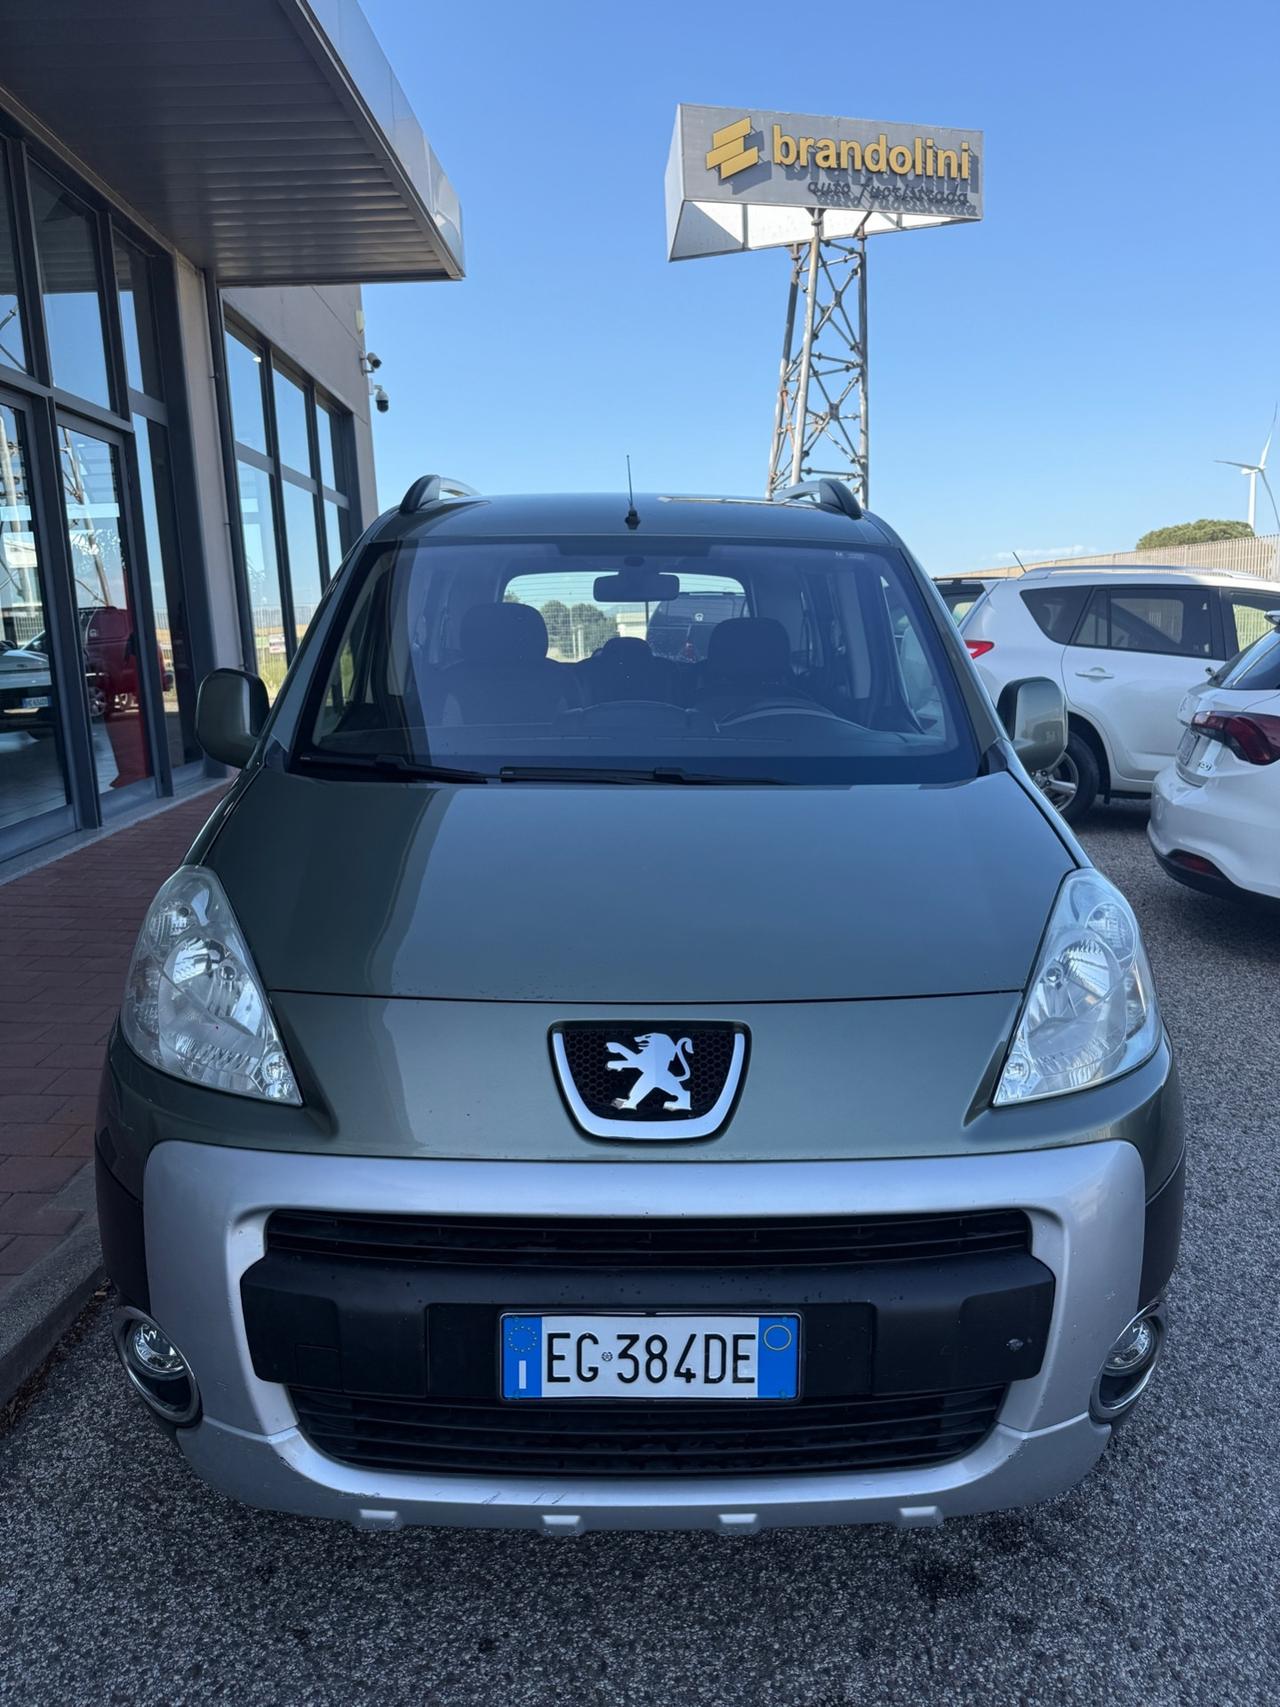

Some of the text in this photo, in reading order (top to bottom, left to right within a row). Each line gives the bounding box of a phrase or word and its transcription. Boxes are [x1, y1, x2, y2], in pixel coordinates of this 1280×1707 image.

[773, 125, 970, 179] brandolini
[808, 181, 851, 197] auto
[518, 1360, 527, 1389] I
